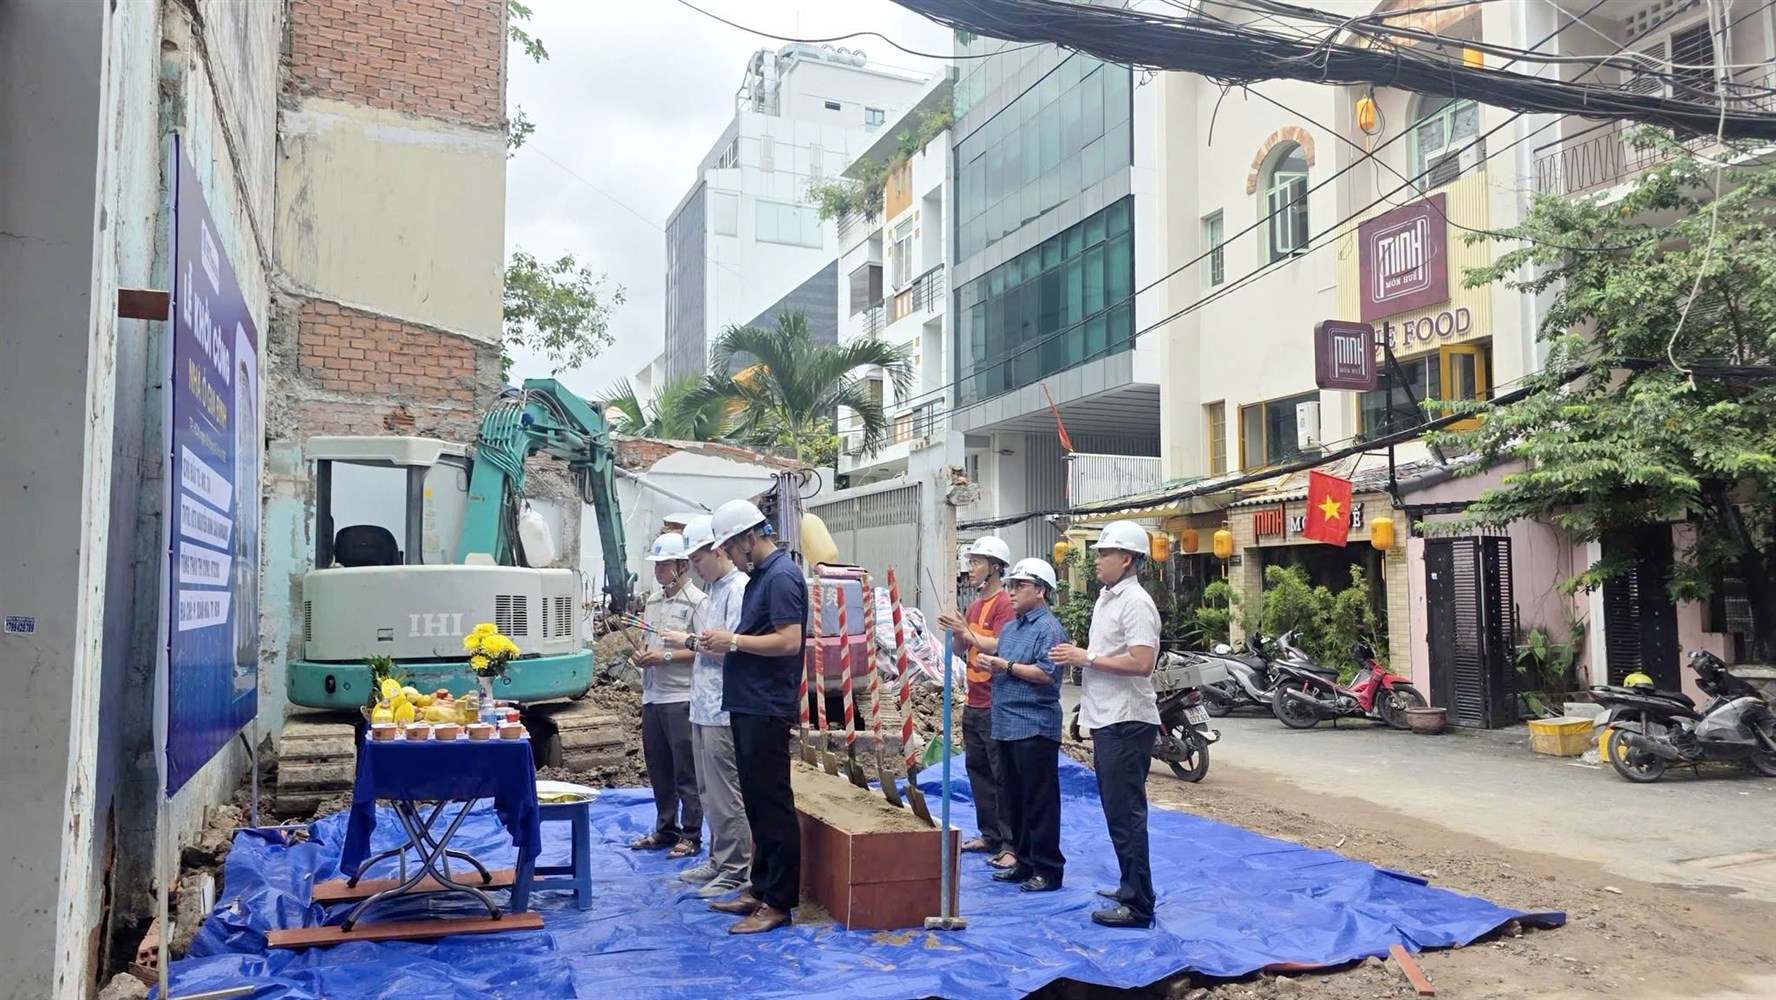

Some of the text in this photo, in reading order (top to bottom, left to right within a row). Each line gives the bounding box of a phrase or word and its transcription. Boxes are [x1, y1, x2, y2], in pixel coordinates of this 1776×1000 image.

[1385, 269, 1417, 289] MÔN HUẾ
[1402, 307, 1471, 346] FOOD
[212, 324, 230, 387] CÔNG
[408, 613, 464, 637] IHI
